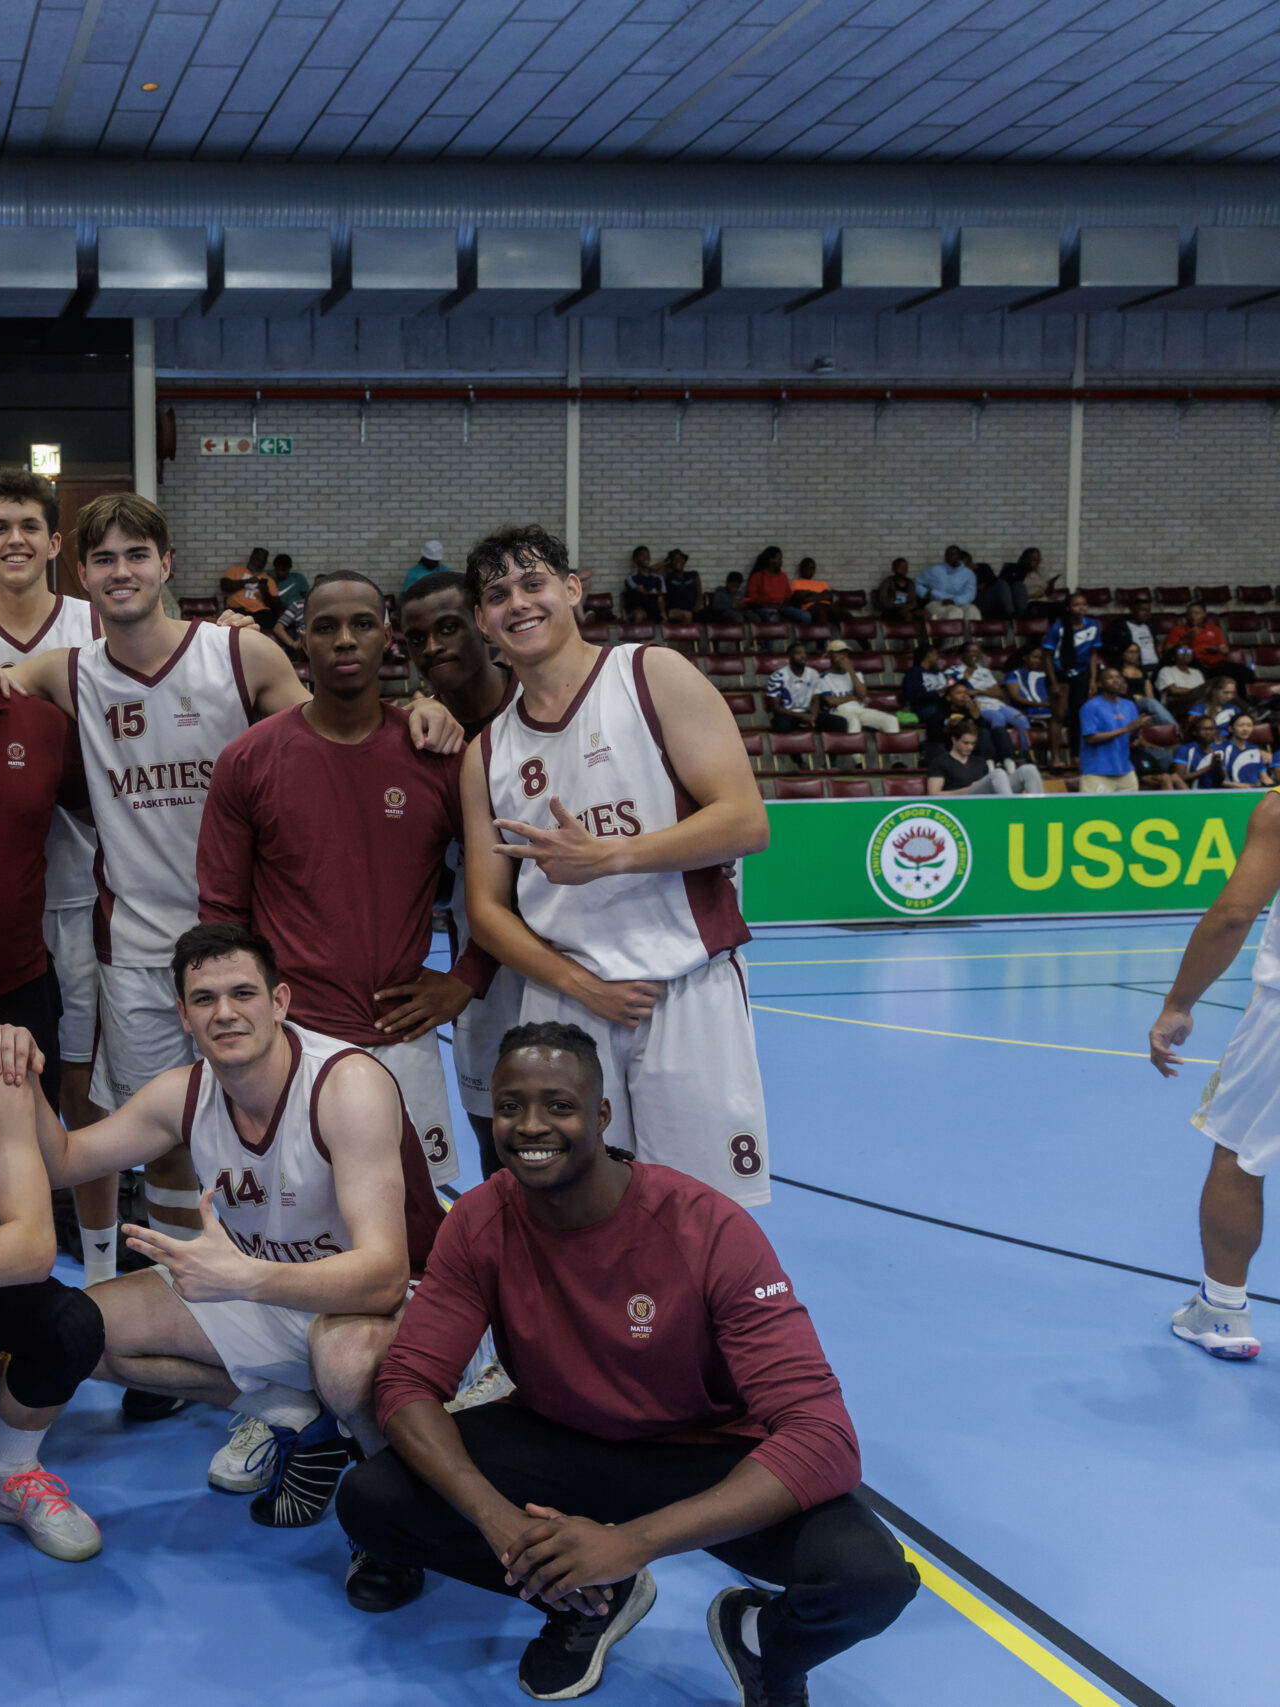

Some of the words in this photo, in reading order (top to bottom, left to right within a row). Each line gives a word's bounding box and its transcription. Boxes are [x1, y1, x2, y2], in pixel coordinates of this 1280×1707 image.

[32, 451, 60, 467] EXIT
[104, 700, 148, 741] 15
[106, 759, 215, 800] MATIES
[518, 756, 550, 800] 8
[133, 796, 196, 810] BASKETBALL
[872, 818, 896, 876] UNIVERSITY
[899, 808, 931, 821] SPORT
[934, 812, 961, 839] SOUTH
[956, 841, 967, 875] AFRICA
[1008, 818, 1237, 891] USSA
[905, 898, 934, 908] USSA
[422, 1123, 450, 1166] 3
[728, 1131, 764, 1178] 8
[214, 1167, 269, 1208] 14
